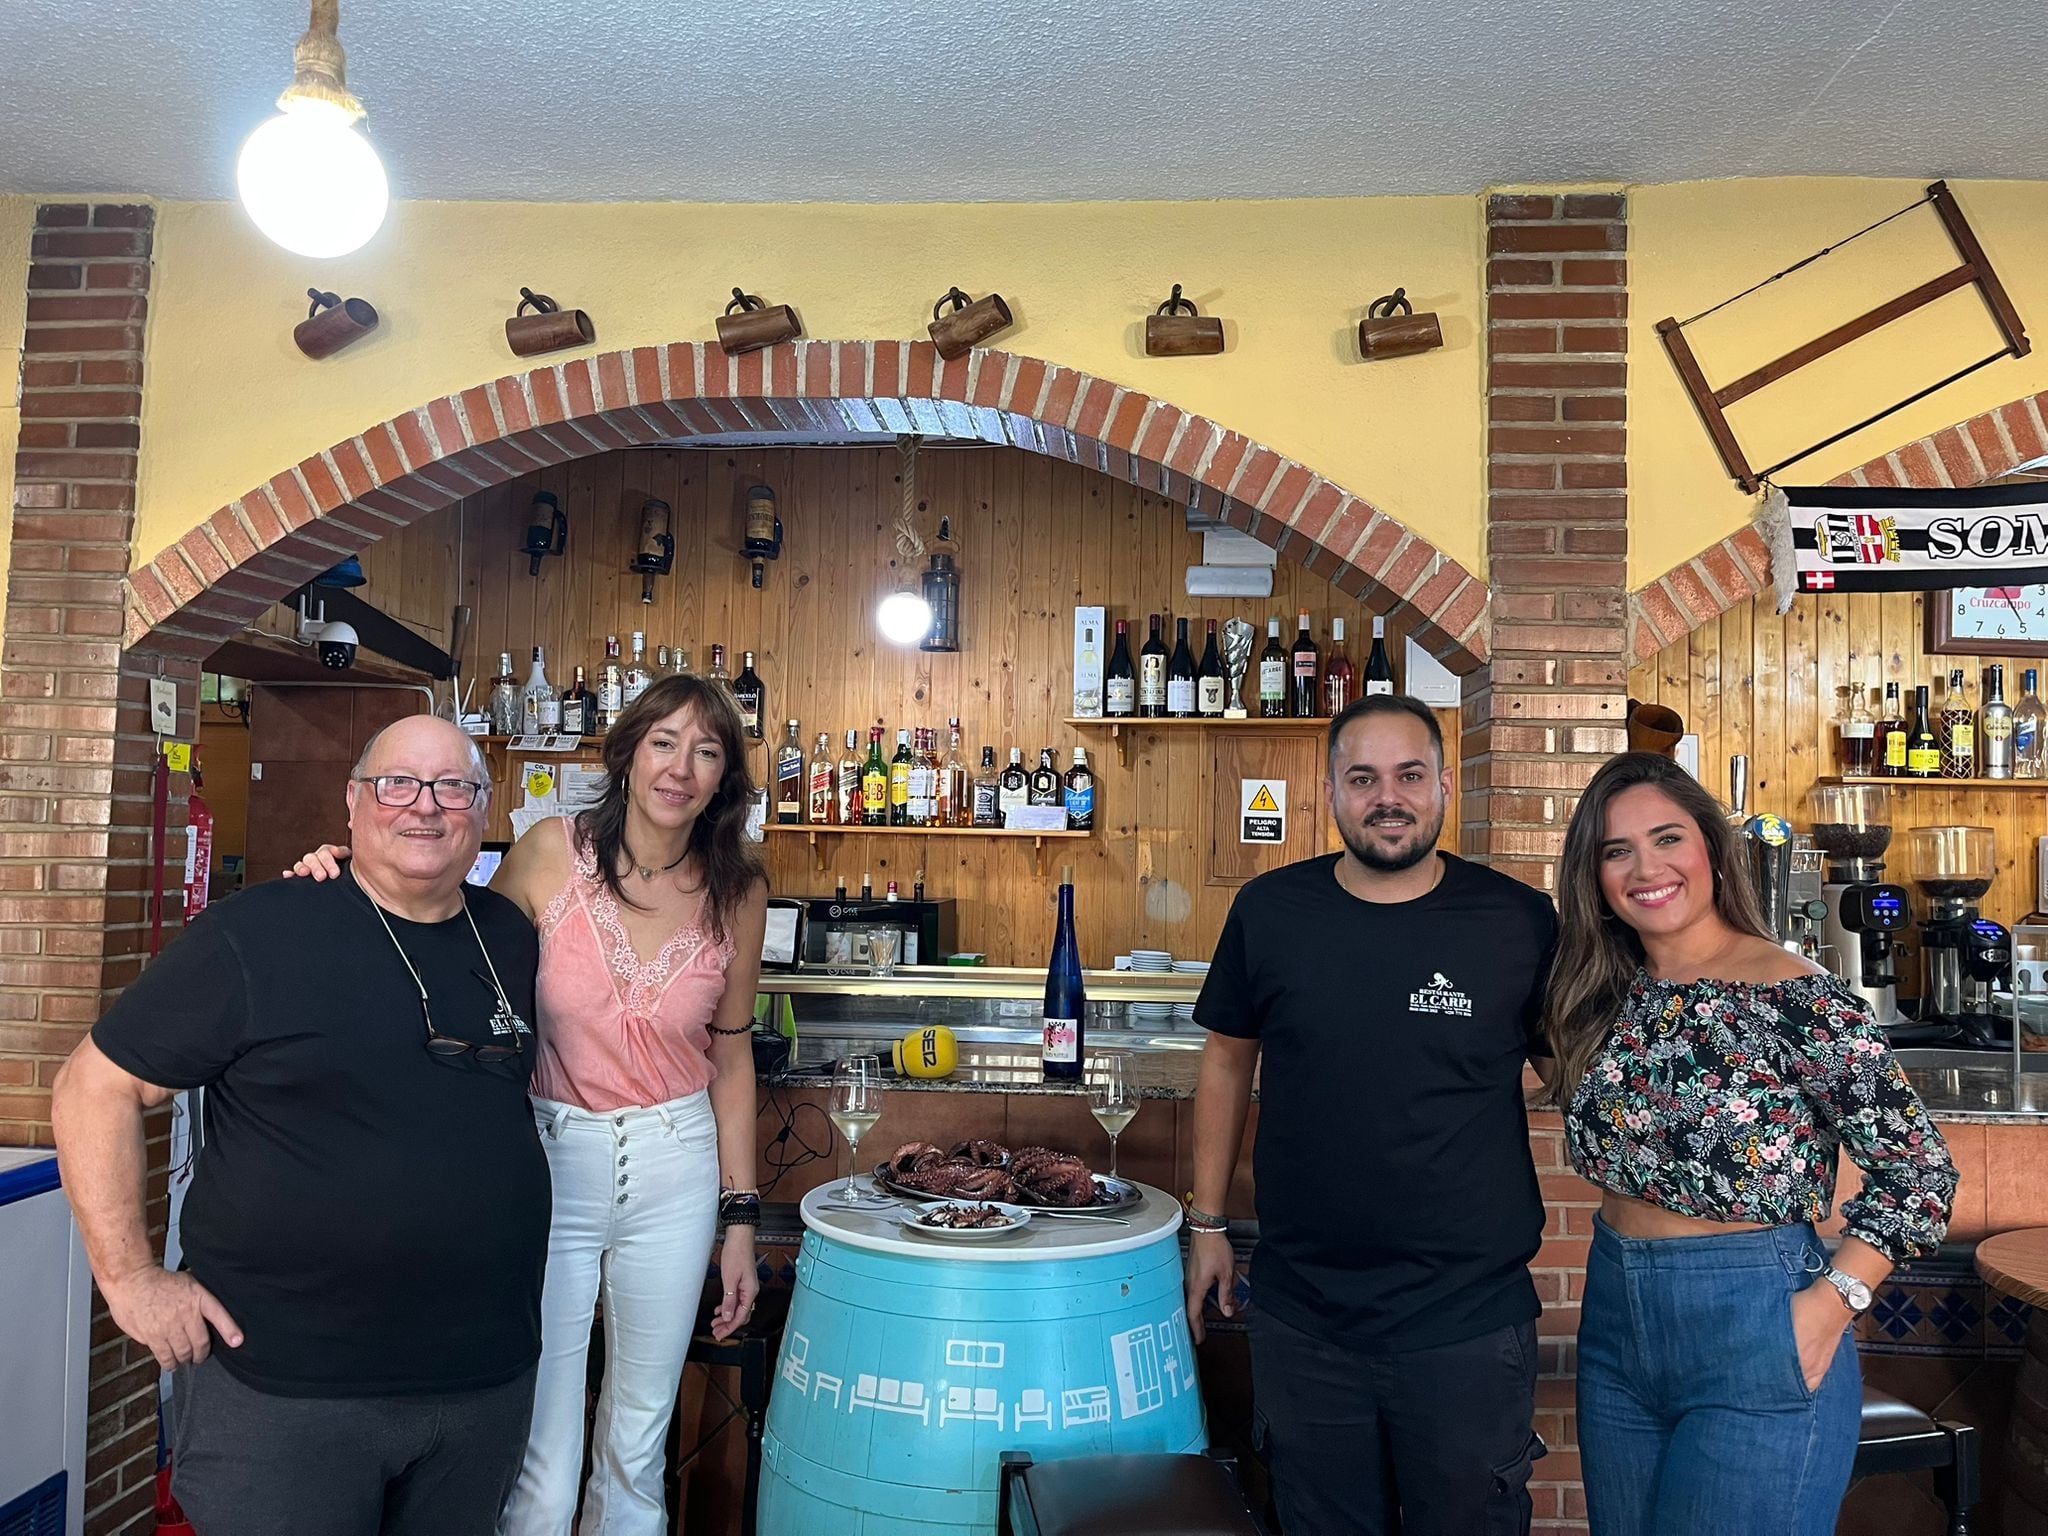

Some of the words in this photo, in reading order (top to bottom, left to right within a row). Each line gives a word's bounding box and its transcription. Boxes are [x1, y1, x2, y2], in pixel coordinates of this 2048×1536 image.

[1958, 604, 1966, 615] 8
[1970, 597, 2031, 611] Cruzcampo
[2036, 607, 2045, 618] 4
[1976, 621, 1983, 633] 7
[1997, 623, 2005, 635] 6
[2019, 622, 2027, 634] 5
[1410, 993, 1428, 1005] EL
[1429, 995, 1472, 1009] CARPI
